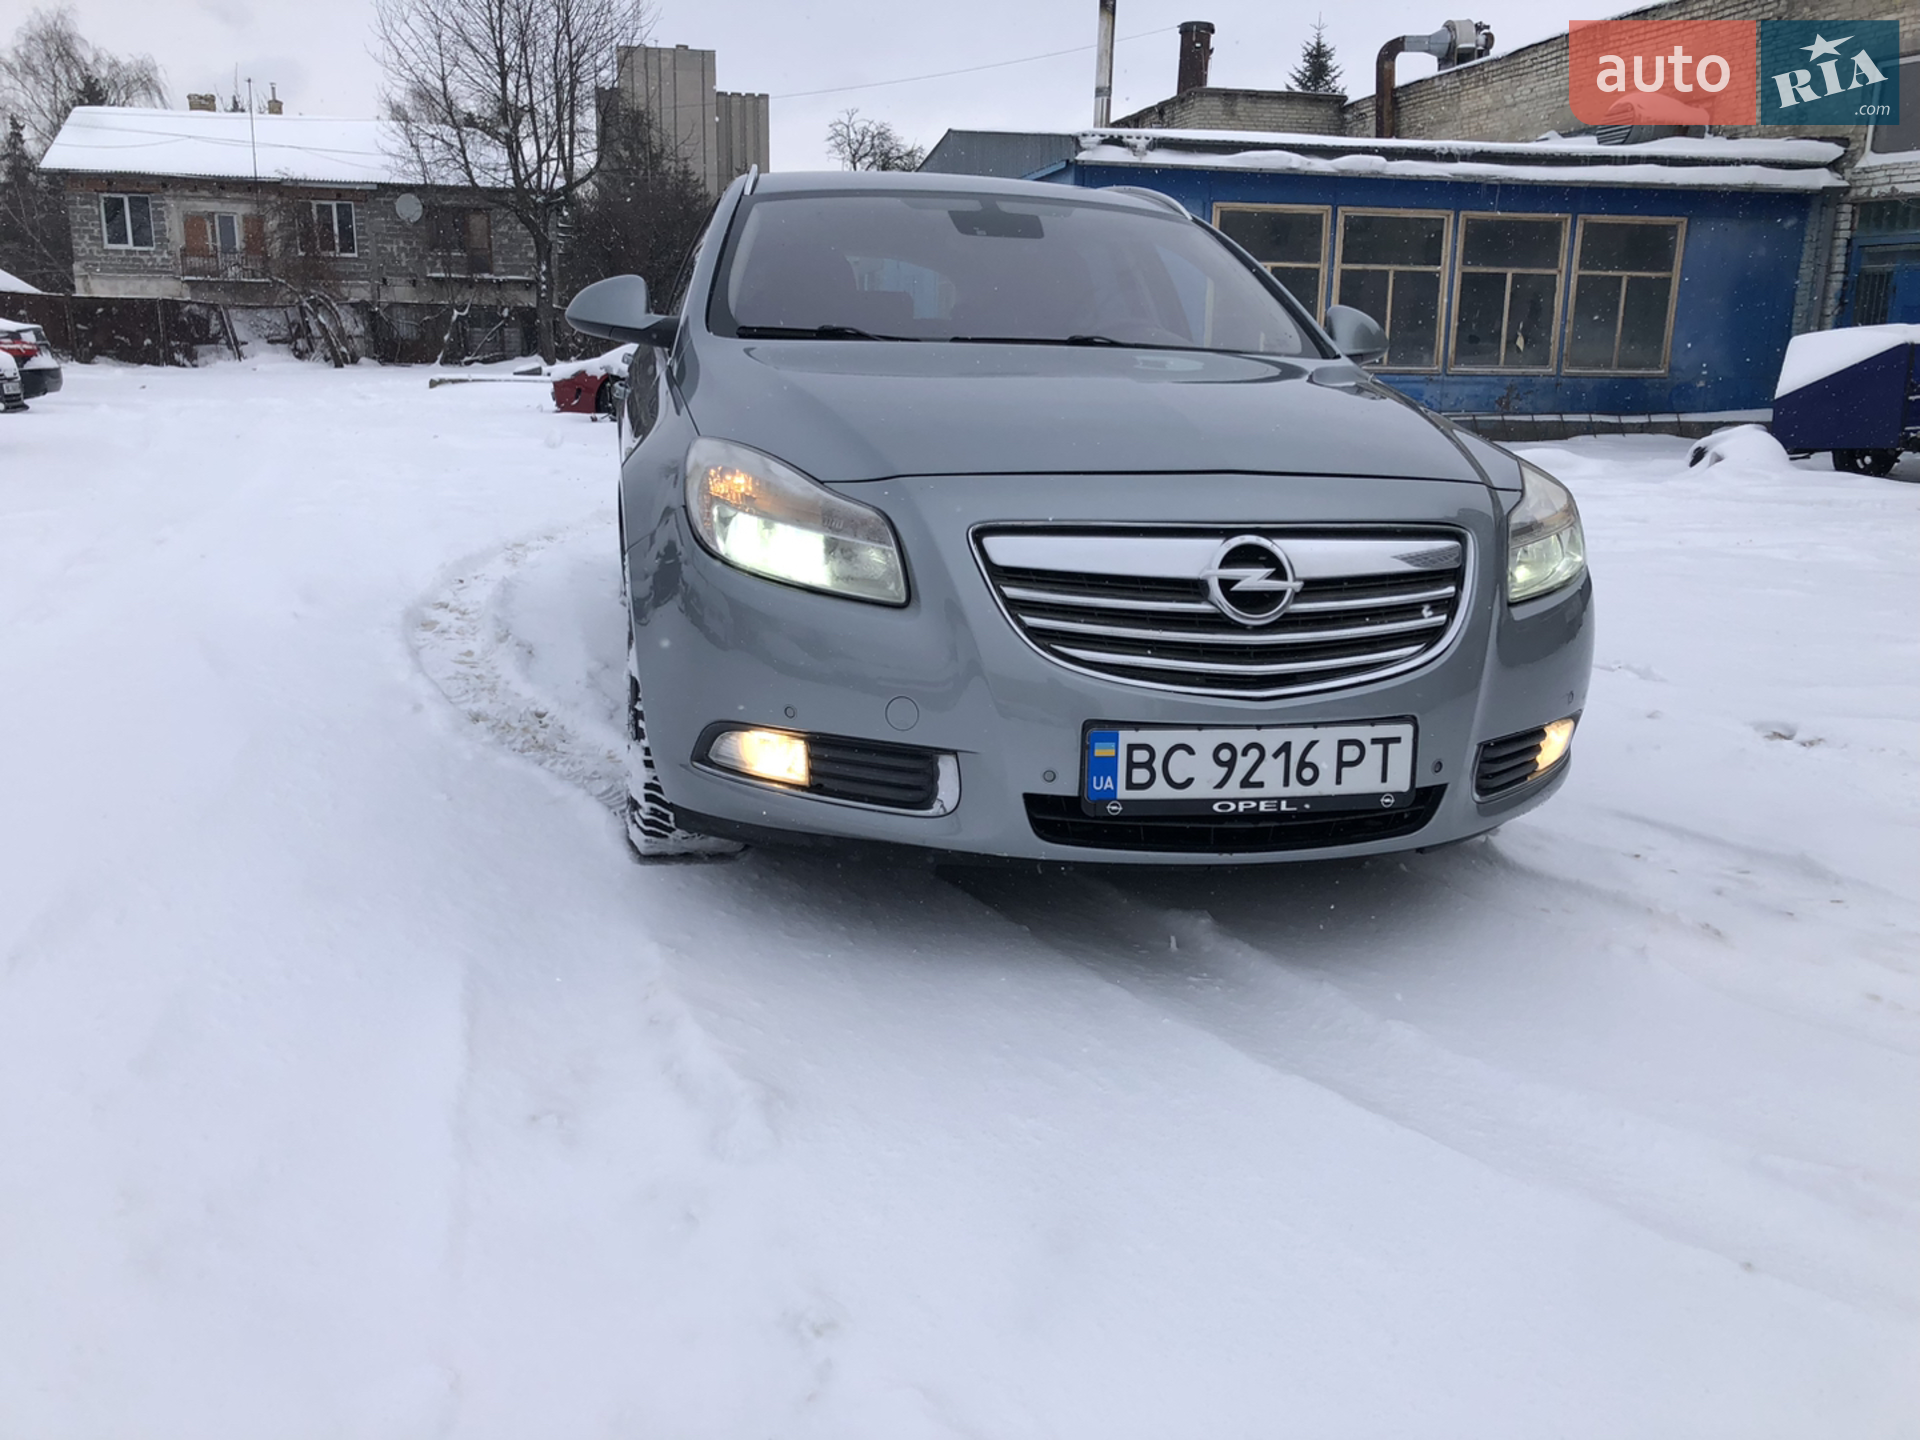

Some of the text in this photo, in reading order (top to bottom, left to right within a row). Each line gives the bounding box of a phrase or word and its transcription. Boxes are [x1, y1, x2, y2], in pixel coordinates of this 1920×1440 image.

[1125, 737, 1402, 791] BC 9216 PT
[1093, 776, 1115, 791] UA
[1212, 800, 1297, 813] OPEL
